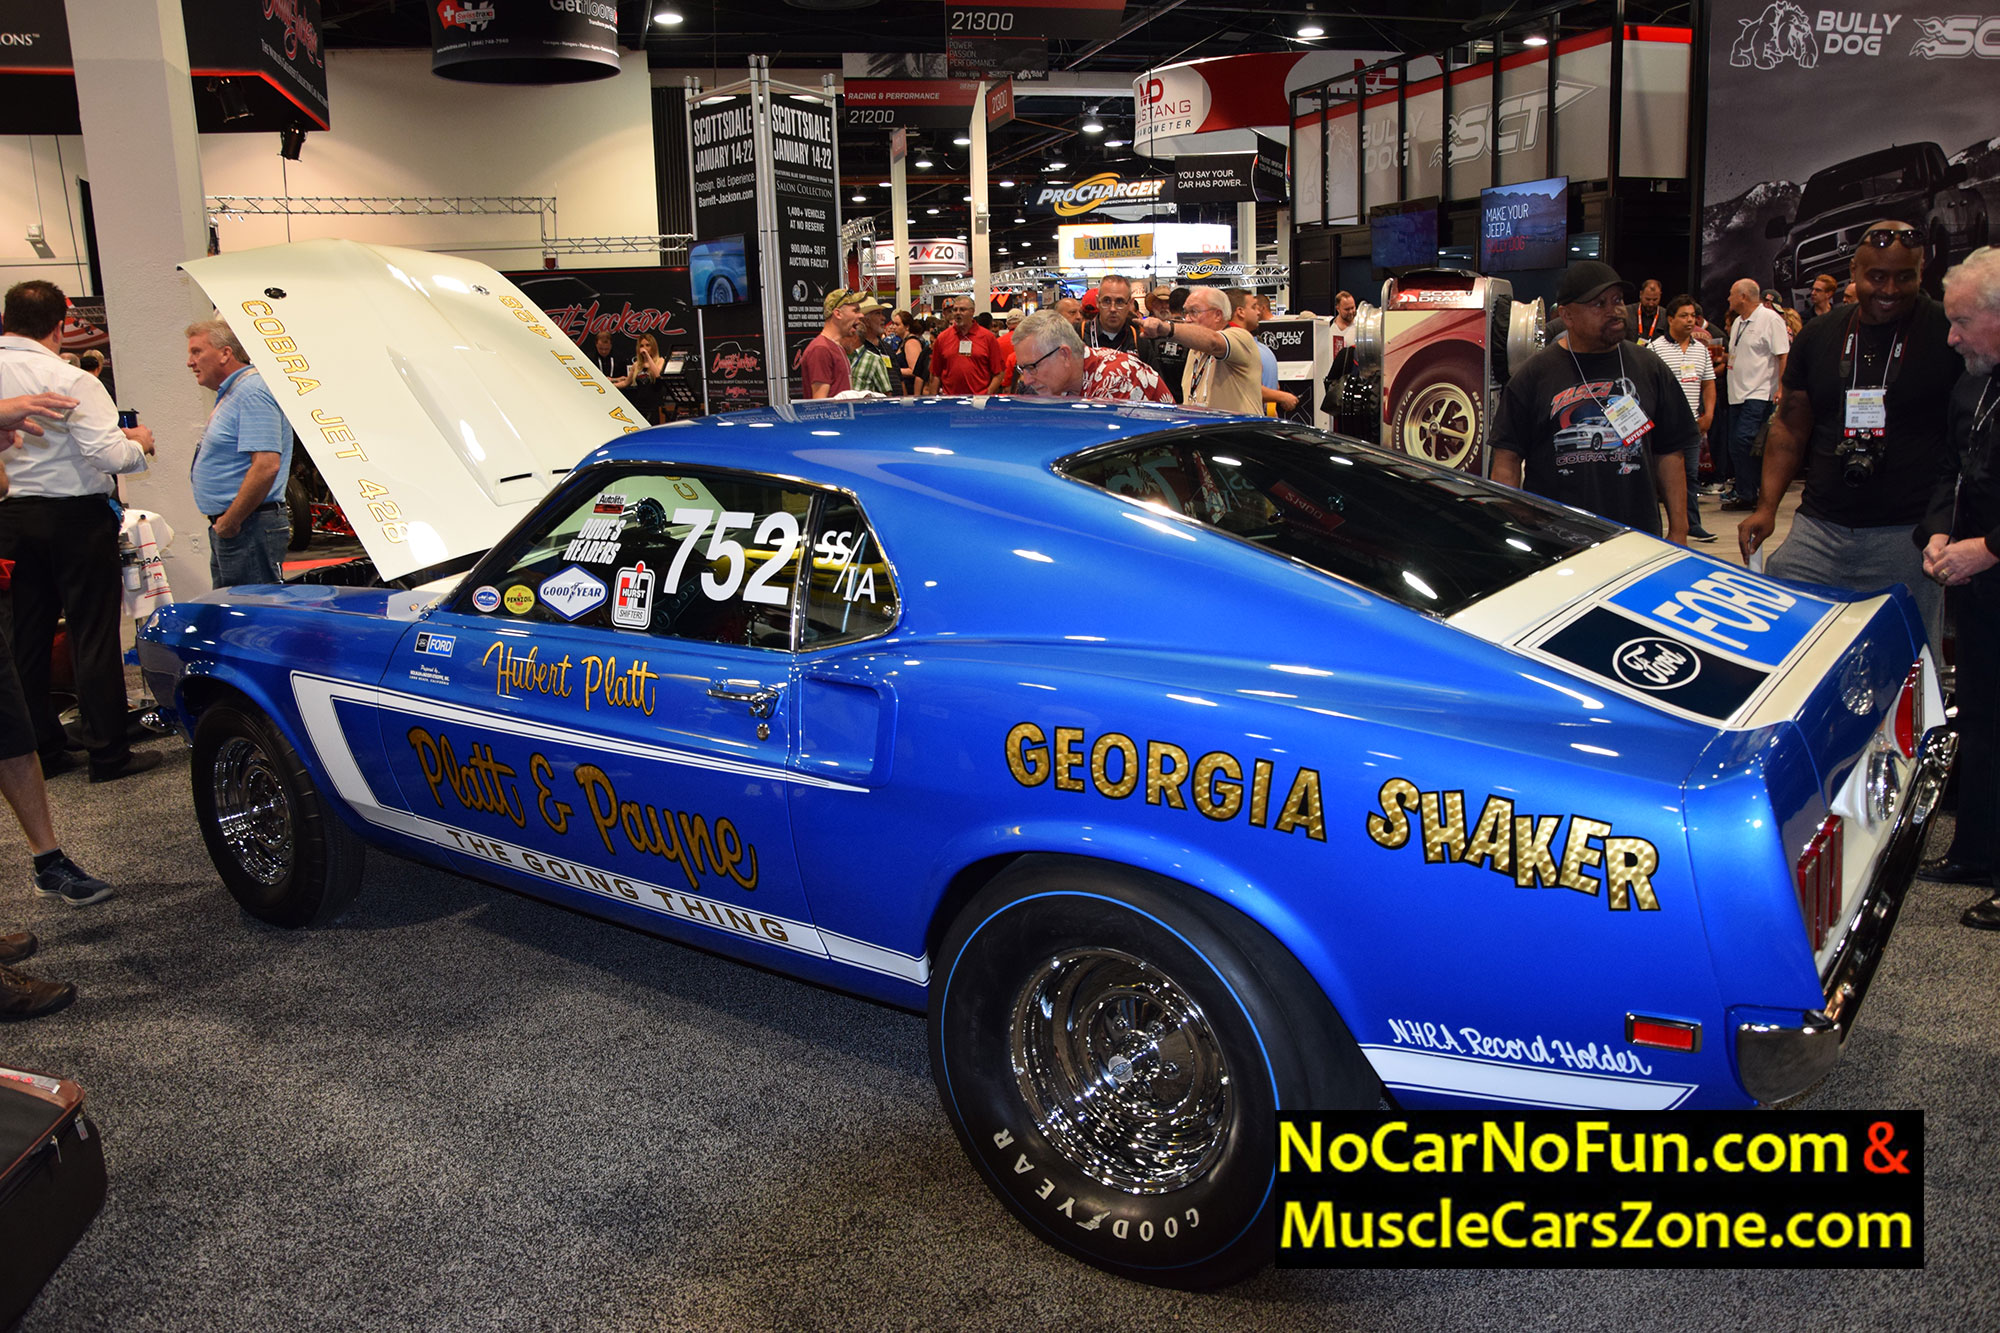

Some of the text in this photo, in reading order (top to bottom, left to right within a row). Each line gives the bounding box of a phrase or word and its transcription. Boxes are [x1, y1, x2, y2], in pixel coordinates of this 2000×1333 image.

[951, 12, 1014, 31] 21300
[1816, 10, 1902, 35] BULLY
[1824, 33, 1882, 56] DOG
[885, 92, 940, 100] PERFORMANCE
[991, 89, 1008, 115] 21300
[694, 105, 753, 147] SCOTTSDALE
[772, 104, 831, 144] SCOTTSDALE
[849, 110, 895, 124] 21200
[695, 144, 730, 173] JANUARY
[774, 138, 809, 165] JANUARY
[1178, 169, 1234, 179] YOU SAY YOUR
[1178, 179, 1248, 189] CAR HAS POWER...
[698, 190, 754, 208] Barrett-Jackson.com
[1036, 179, 1163, 206] PROCHARGER
[805, 208, 826, 220] VEHICLES
[1486, 203, 1529, 222] MAKE YOUR
[790, 220, 825, 232] AT NO RESERVE
[1486, 221, 1512, 238] JEEP A
[908, 246, 954, 260] ANZO
[1089, 235, 1140, 251] ULTIMATE
[789, 258, 829, 269] AUCTION FACILITY
[1177, 263, 1245, 274] PROCHARGER
[498, 294, 552, 340] 428
[1276, 331, 1304, 340] BULLY
[1281, 337, 1302, 345] DOG
[551, 349, 606, 395] JET
[1550, 381, 1615, 420] TASCA
[240, 299, 409, 545] COBRA JET 428
[1556, 453, 1607, 466] COBRA
[599, 494, 625, 504] Autolite
[578, 517, 628, 541] DOUG'S
[562, 539, 622, 565] HEADERS
[663, 508, 800, 607] 752
[621, 588, 646, 599] HURST
[618, 609, 644, 620] SHIFTERS
[1651, 571, 1798, 651] FORD
[430, 639, 452, 652] FORD
[1621, 643, 1689, 686] Ford
[482, 641, 660, 717] Hubert Platt
[407, 726, 759, 891] Platt & Payne
[1004, 721, 1662, 912] GEORGIA SHAKER
[446, 828, 790, 943] THE GOING THING
[1459, 1027, 1555, 1065] Record
[1551, 1039, 1652, 1076] Holder
